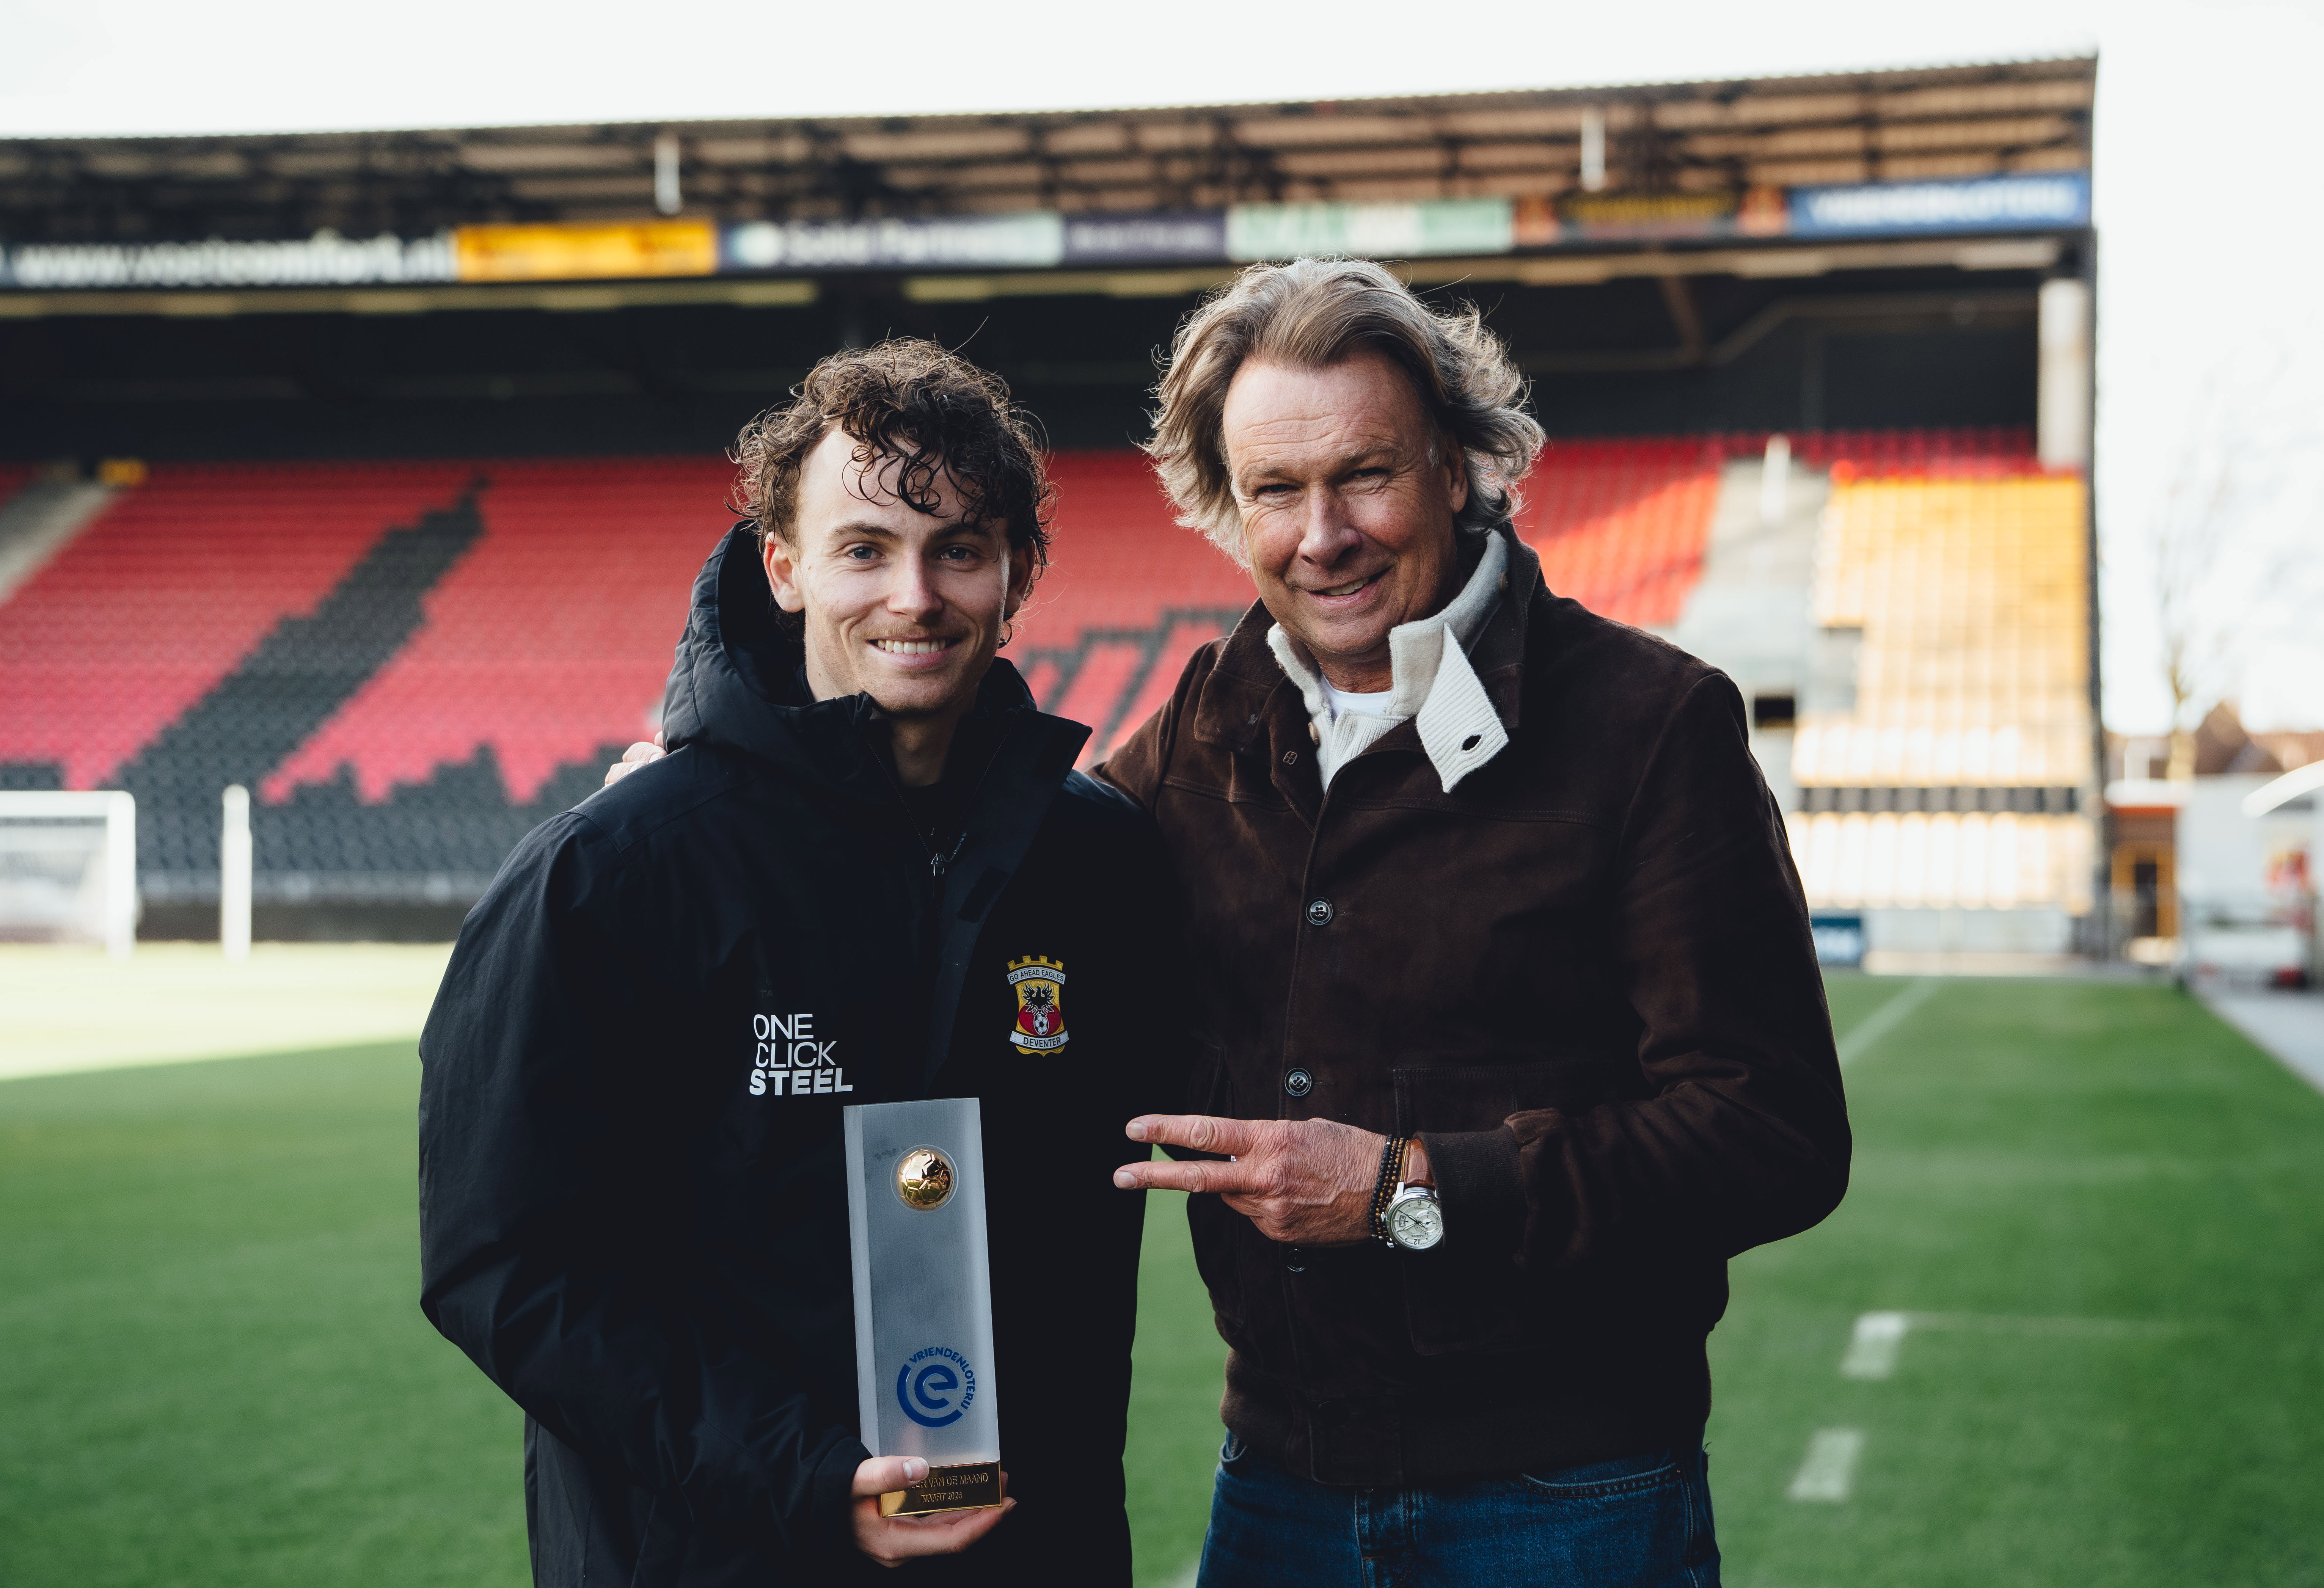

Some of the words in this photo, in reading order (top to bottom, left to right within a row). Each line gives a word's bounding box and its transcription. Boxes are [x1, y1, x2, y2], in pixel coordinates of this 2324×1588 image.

[1010, 973, 1019, 982] GO
[1020, 969, 1040, 978] AHEAD
[1041, 970, 1064, 982] EAGLES
[753, 1014, 814, 1040] ONE
[1023, 1037, 1061, 1047] DEVENTER
[756, 1040, 837, 1068] CLICK
[749, 1068, 853, 1095] STEEL
[909, 1346, 975, 1410] VRIENDENLOTERIJ
[928, 1477, 945, 1489] VAN
[947, 1475, 958, 1486] DE
[959, 1472, 988, 1485] MAAND
[921, 1492, 946, 1503] MAART
